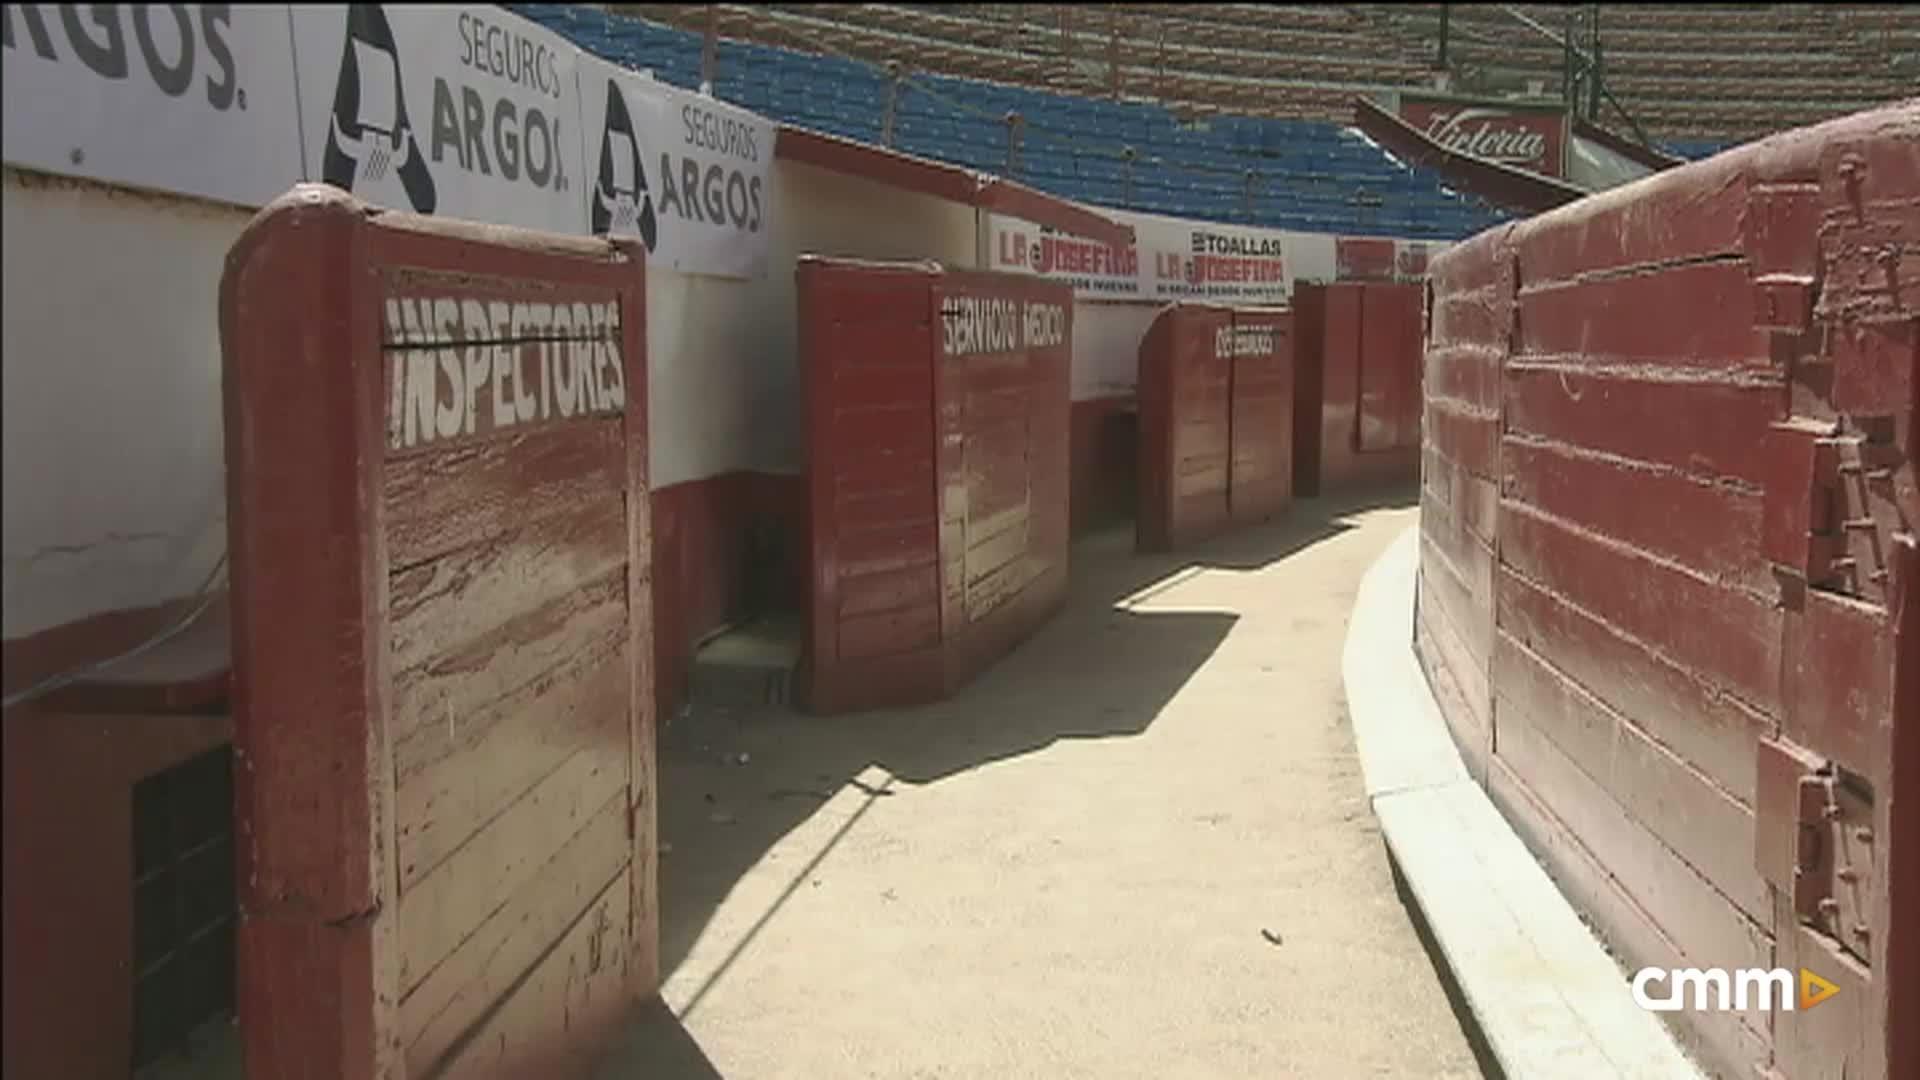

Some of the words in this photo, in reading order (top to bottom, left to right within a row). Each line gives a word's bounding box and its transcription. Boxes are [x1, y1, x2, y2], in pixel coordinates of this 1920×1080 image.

[682, 103, 758, 162] SEGUROS
[1425, 108, 1544, 164] Victoria
[658, 152, 761, 233] ARGOS
[999, 231, 1026, 266] LA
[1030, 236, 1138, 275] JOSEFINA
[1156, 252, 1179, 279] LA
[1184, 254, 1284, 286] JOSEFINA
[1206, 233, 1282, 256] TOALLAS
[942, 295, 1017, 355] SERVICIO
[1023, 300, 1063, 347] MEDICO
[385, 297, 626, 449] INSPECTORES
